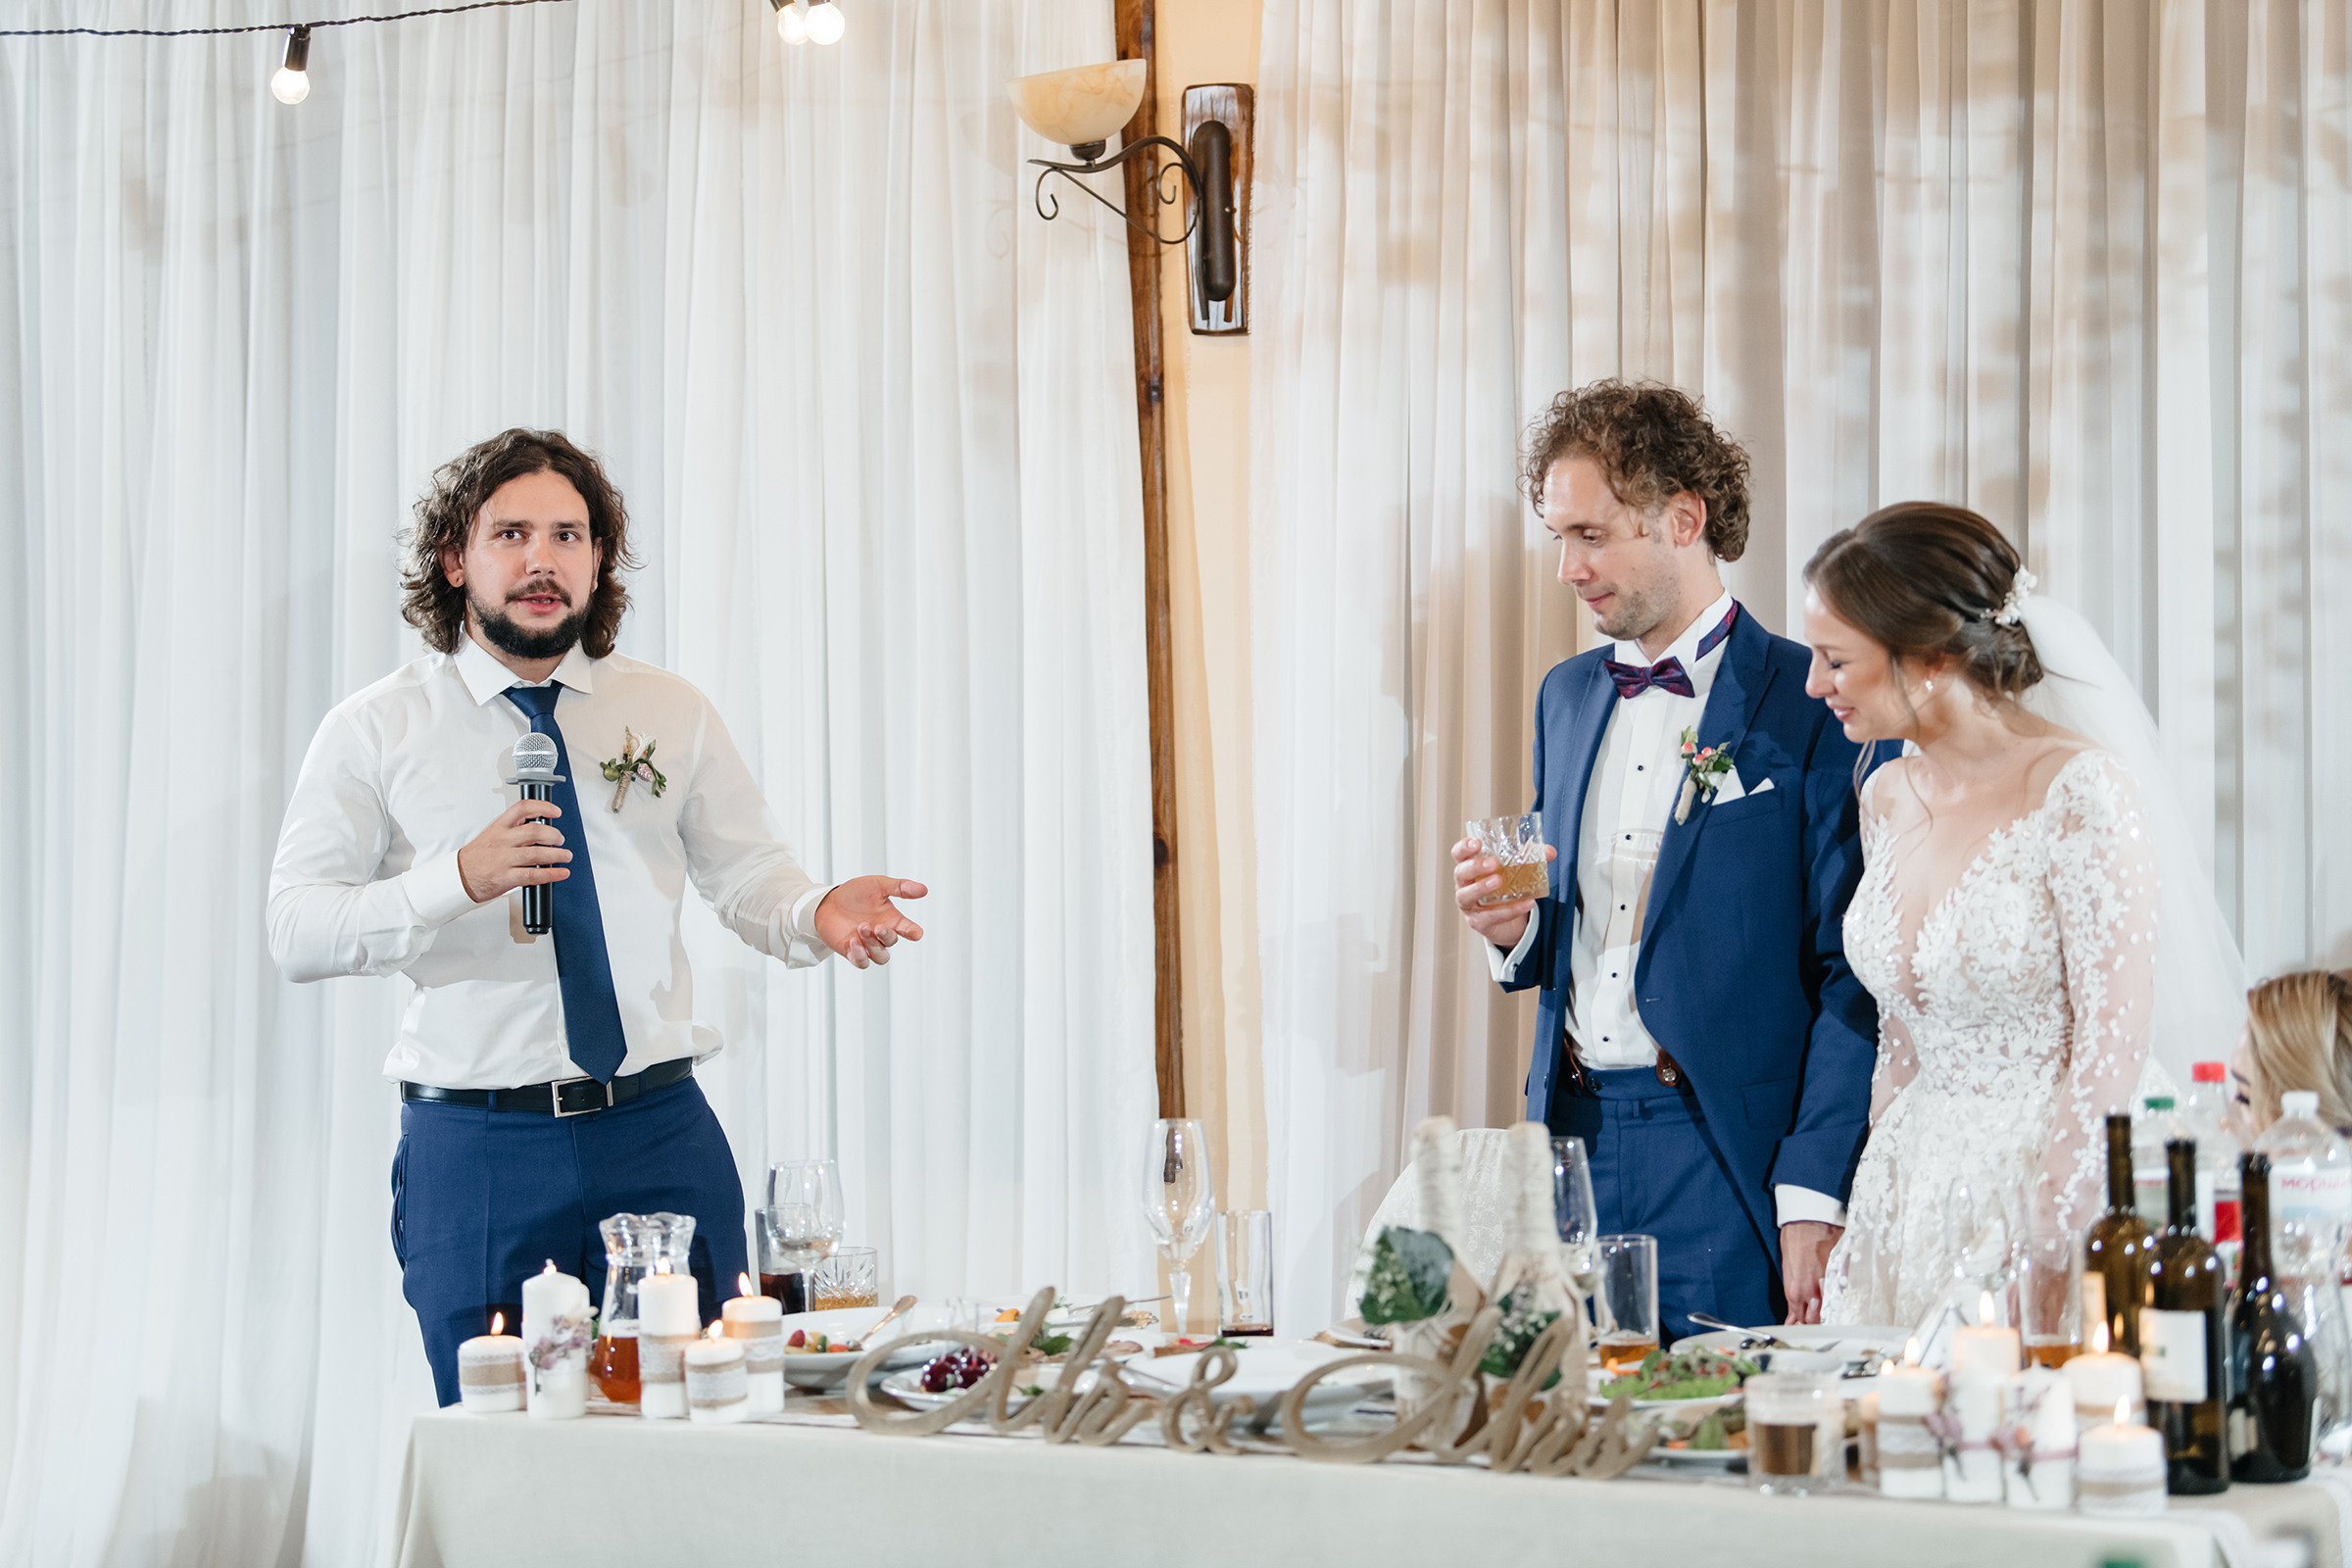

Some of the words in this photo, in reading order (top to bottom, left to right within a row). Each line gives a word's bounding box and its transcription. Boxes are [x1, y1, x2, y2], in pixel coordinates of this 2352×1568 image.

[846, 1286, 1154, 1447] Mr
[1161, 1347, 1257, 1454] &
[1282, 1305, 1660, 1481] Mrs
